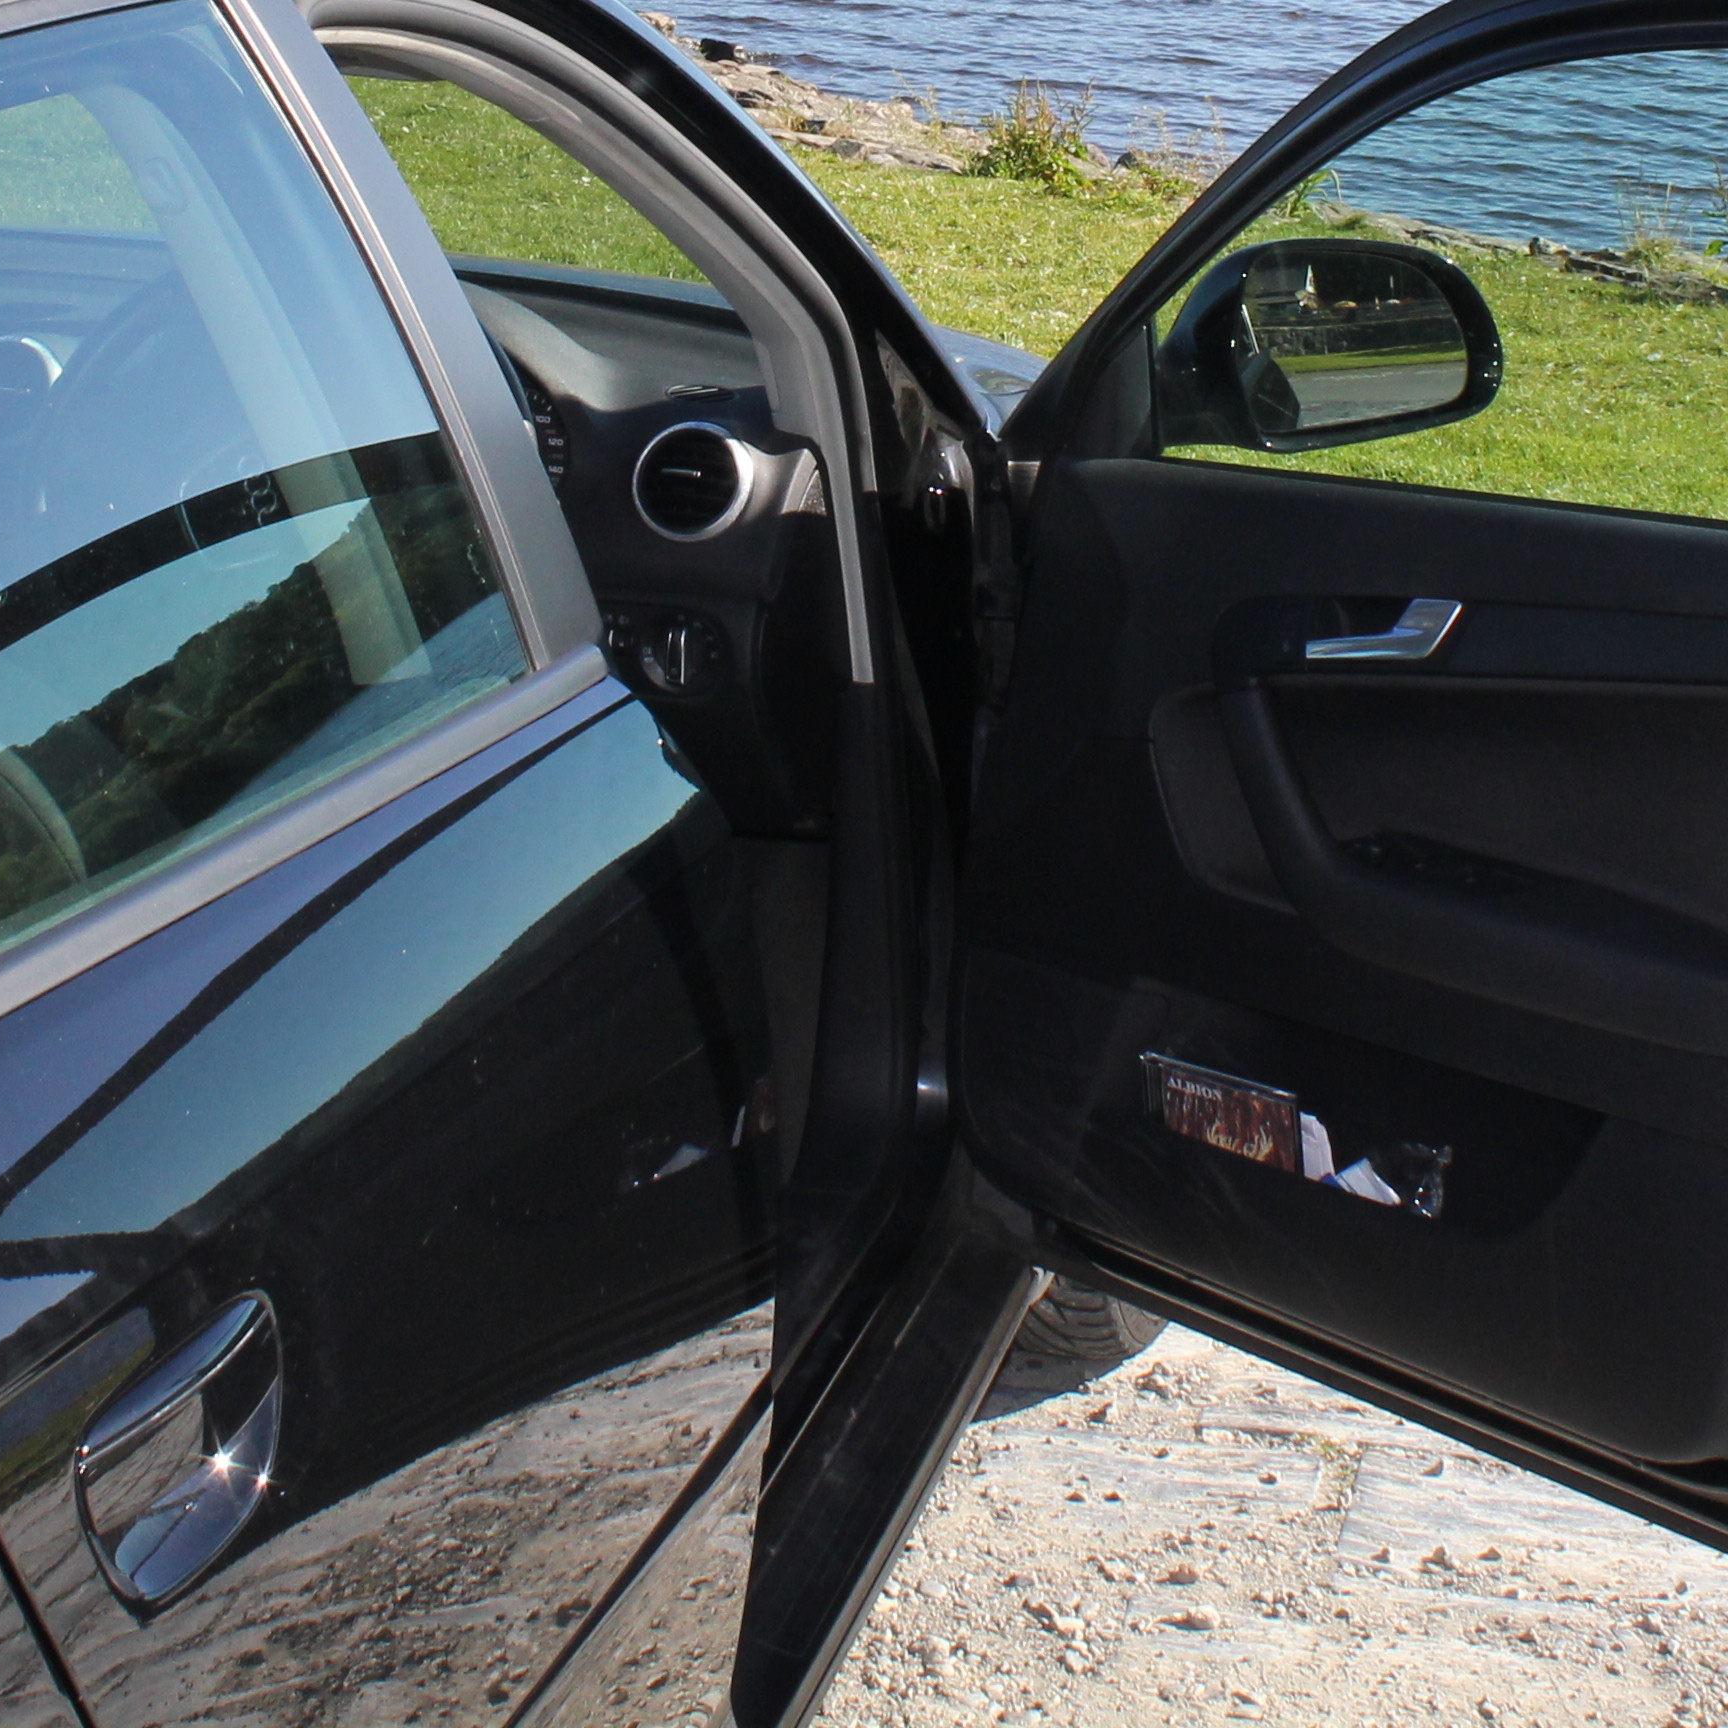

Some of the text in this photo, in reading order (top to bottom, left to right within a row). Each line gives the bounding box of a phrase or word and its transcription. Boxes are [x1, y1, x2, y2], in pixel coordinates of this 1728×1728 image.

[535, 415, 551, 424] 100
[548, 438, 564, 446] 120
[548, 465, 564, 474] 140
[1167, 1076, 1223, 1101] ALBION
